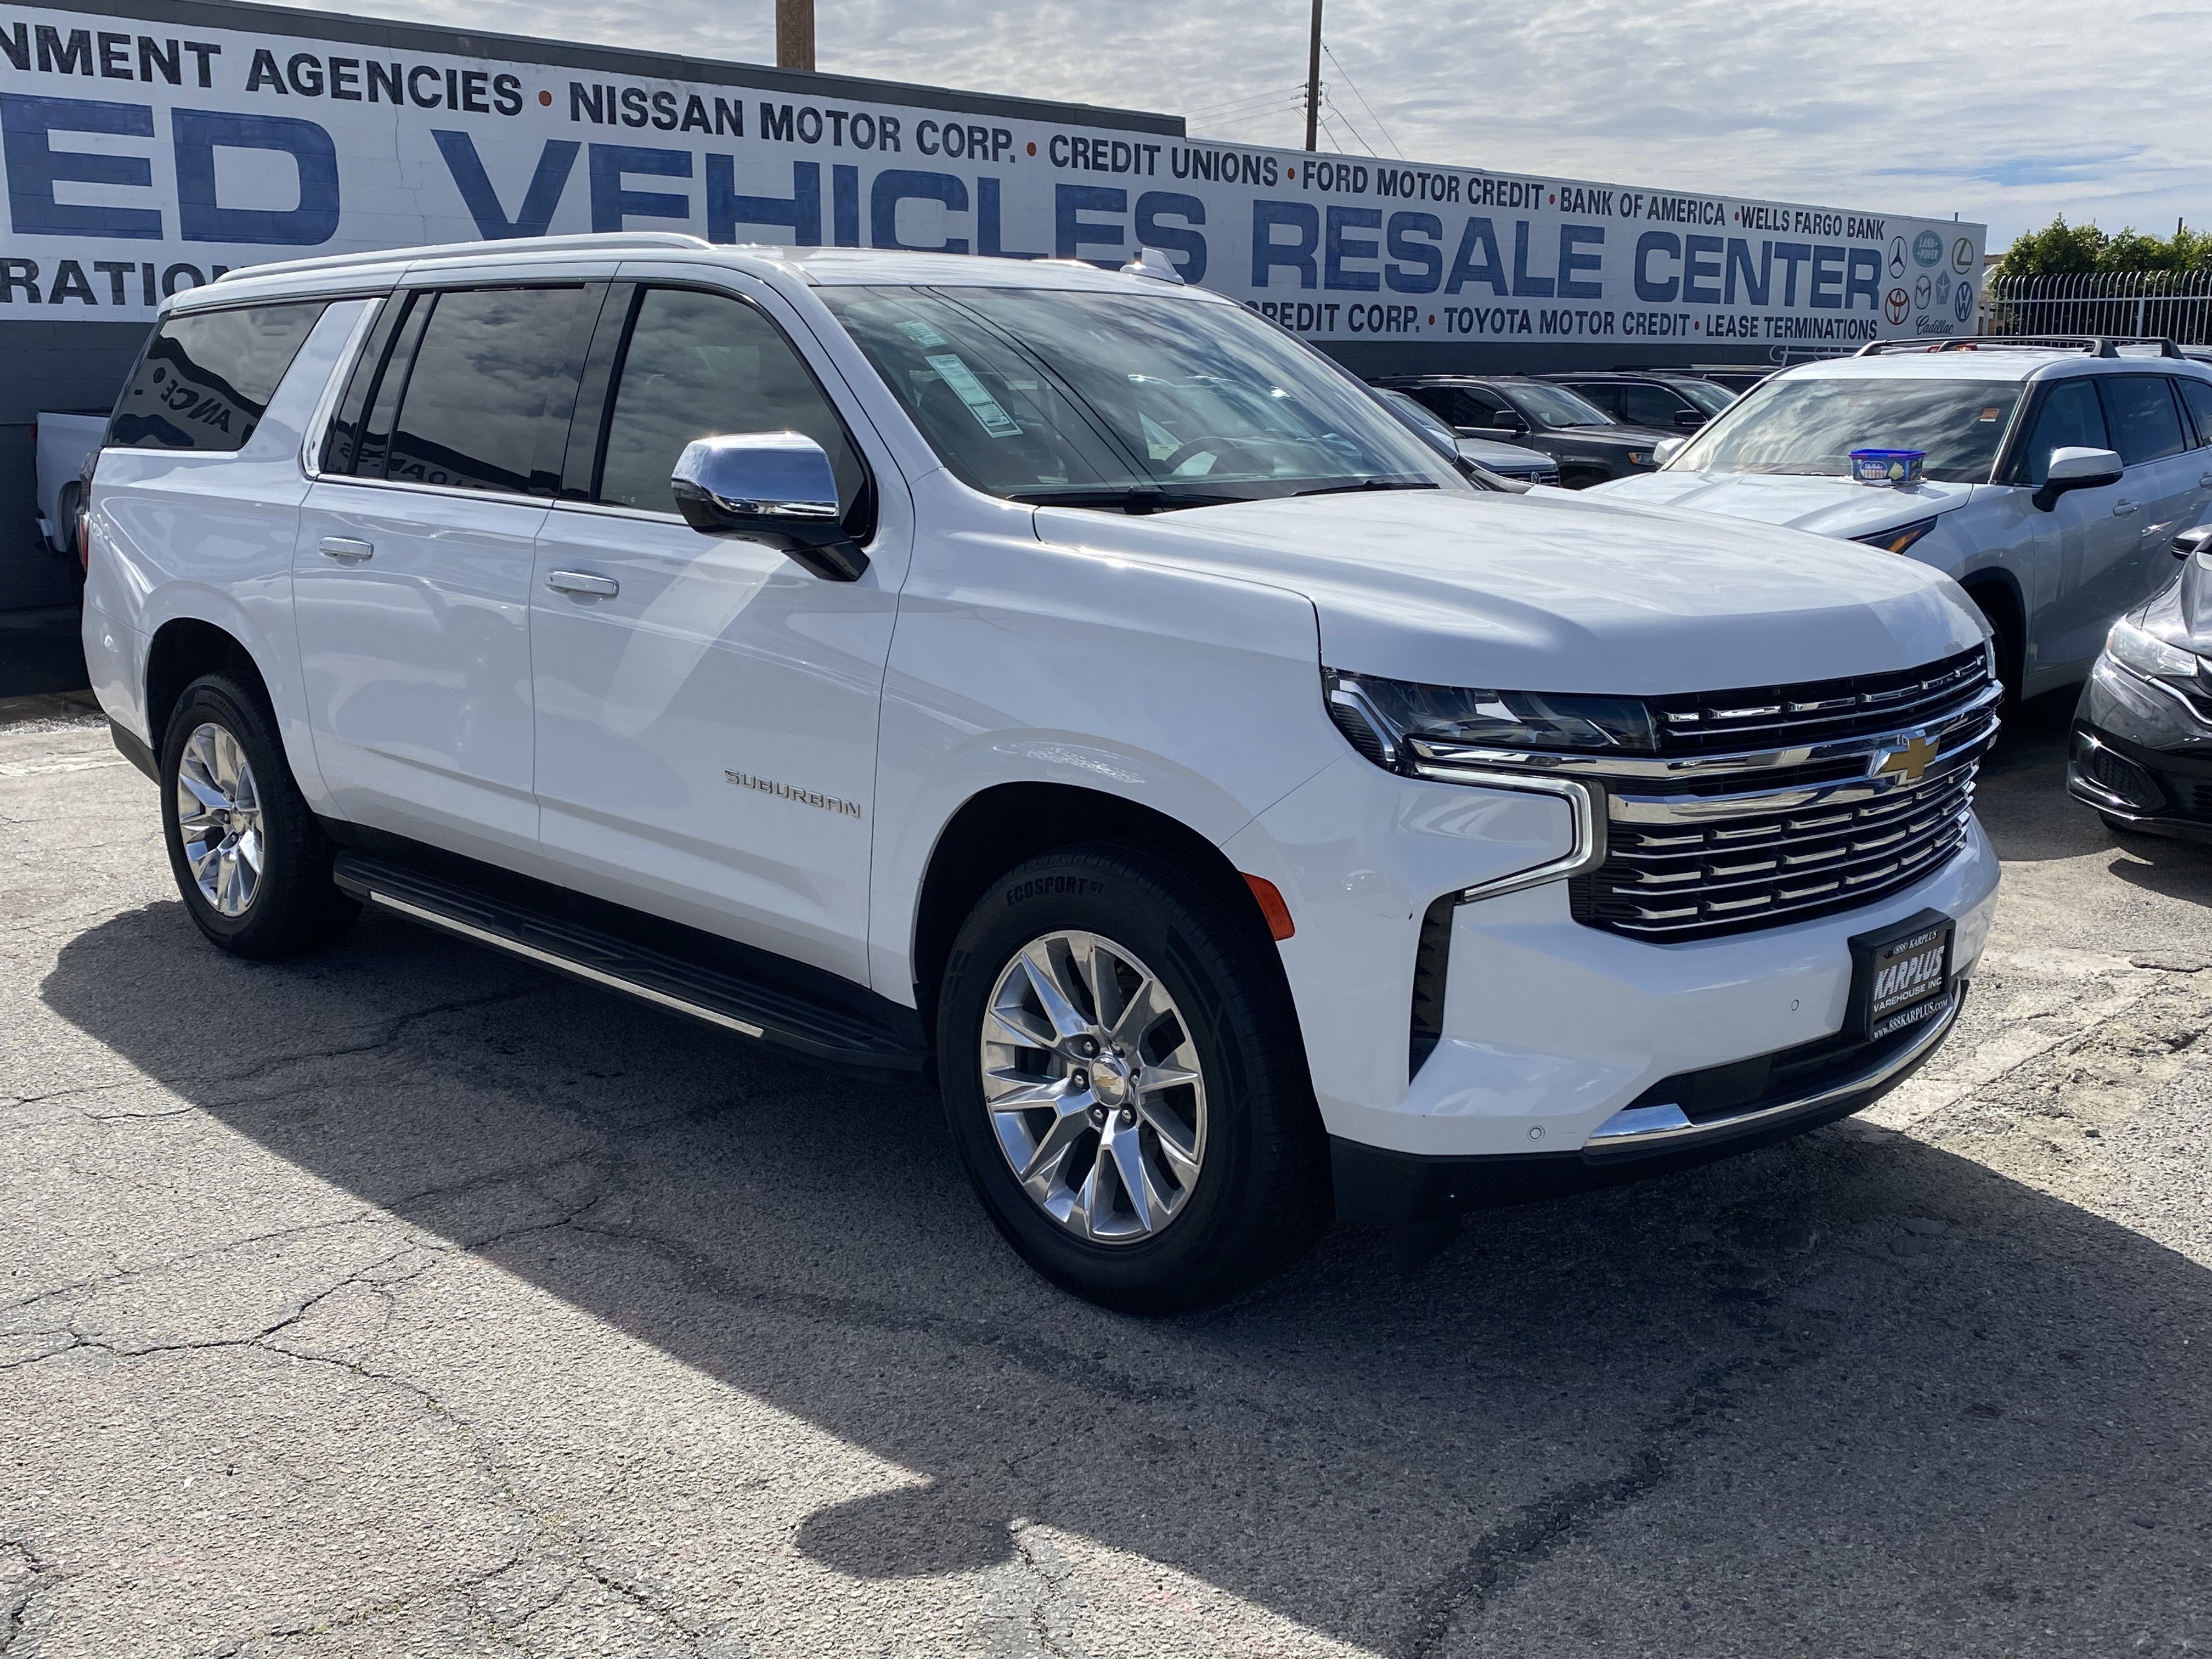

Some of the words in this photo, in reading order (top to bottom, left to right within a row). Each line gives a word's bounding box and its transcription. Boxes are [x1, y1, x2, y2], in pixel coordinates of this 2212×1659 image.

[246, 49, 523, 116] AGENCIES
[570, 82, 743, 137] NISSAN
[760, 103, 901, 152] MOTOR
[917, 120, 1015, 163] CORP.
[1049, 134, 1161, 176] CREDIT
[1172, 146, 1278, 187] UNIONS
[1302, 161, 1368, 194] FORD
[1377, 168, 1460, 203] MOTOR
[1468, 177, 1545, 211] CREDIT
[1560, 187, 1613, 216] BANK
[1620, 193, 1644, 219] OF
[1646, 195, 1726, 226] AMERICA
[430, 129, 1207, 285] VEHICLES
[1251, 200, 1606, 299] RESALE
[1634, 230, 1882, 310] CENTER
[1741, 205, 1790, 232] WELLS
[1795, 211, 1843, 238] FARGO
[1847, 216, 1886, 241] BANK
[0, 257, 249, 306] RATIO
[1348, 303, 1420, 334] CORP.
[1444, 307, 1533, 335] TOYOTA
[1539, 309, 1615, 335] MOTOR
[1622, 312, 1690, 337] CREDIT
[1706, 314, 1758, 338] LEASE
[1764, 317, 1877, 340] TERMINATIONS
[1916, 315, 1954, 335] Cadillac
[724, 768, 861, 818] SUBURBAN
[1006, 876, 1088, 907] ECOSPORT
[1874, 945, 1945, 1001] KARPLUS
[1927, 977, 1942, 990] INC
